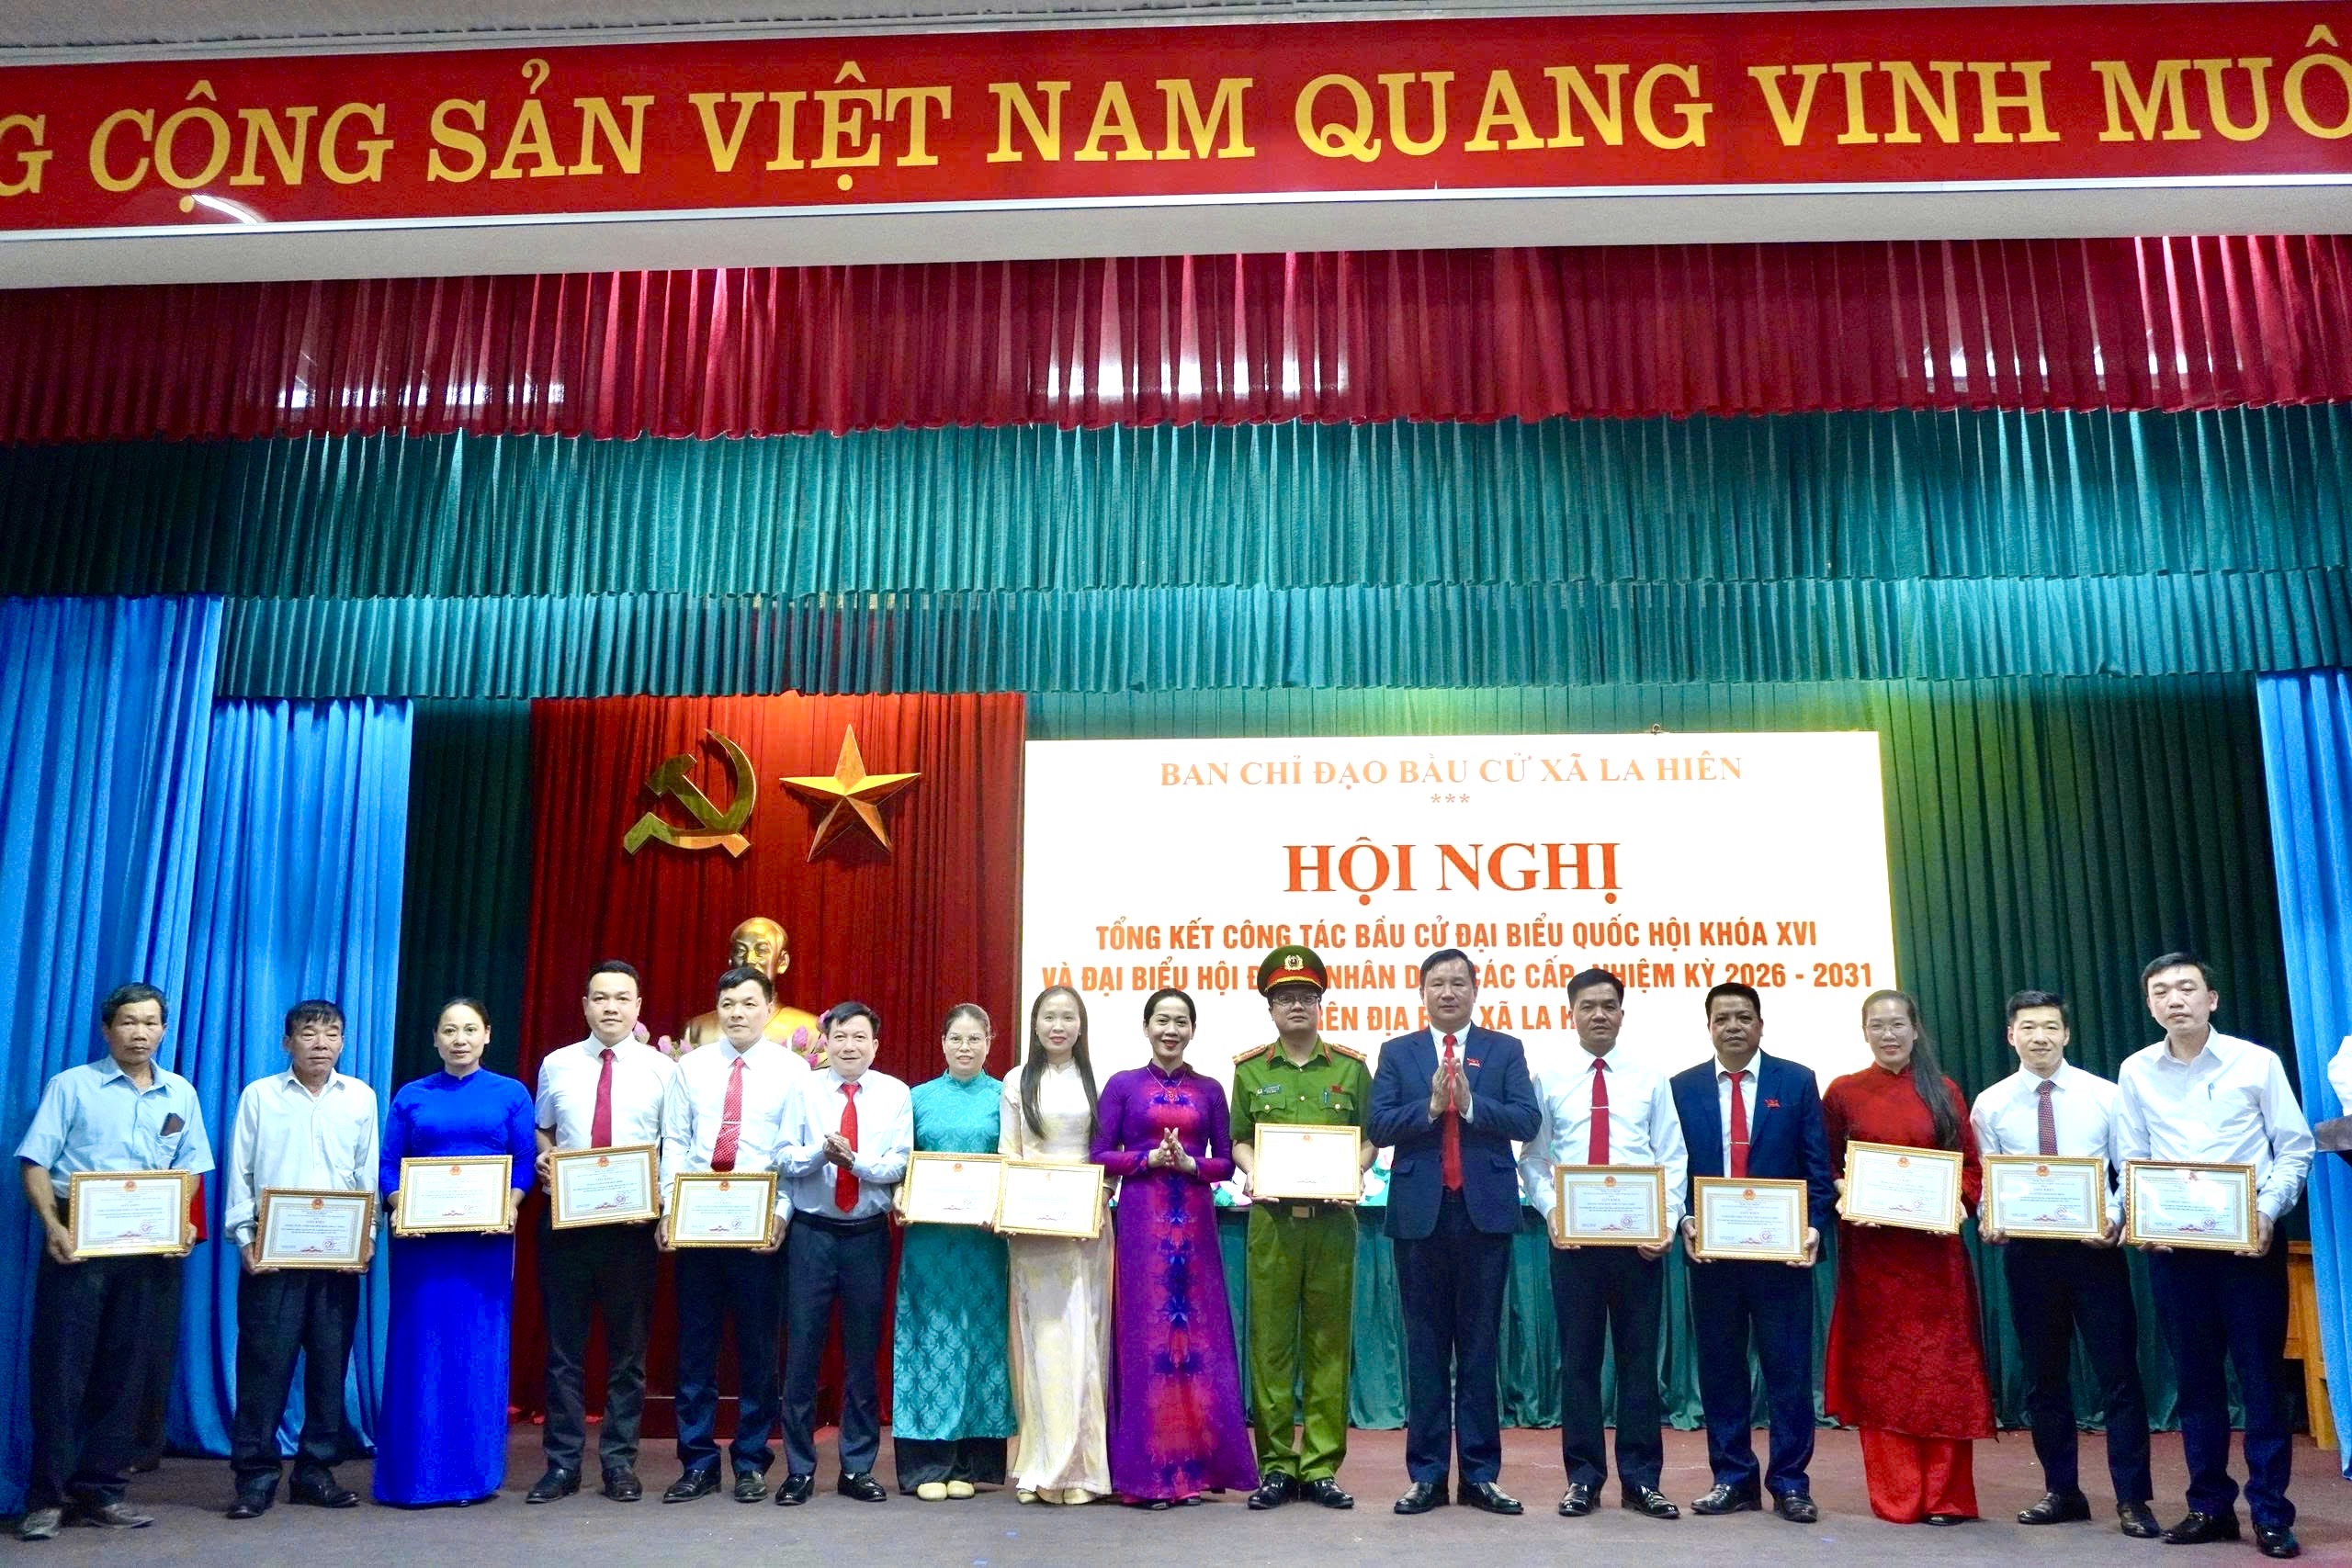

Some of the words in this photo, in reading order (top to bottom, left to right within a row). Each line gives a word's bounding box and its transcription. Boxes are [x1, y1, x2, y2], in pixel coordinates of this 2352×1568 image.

[89, 81, 394, 212] CỘNG
[427, 59, 655, 183] SẢN
[689, 61, 952, 191] VIỆT
[987, 77, 1256, 164] NAM
[1295, 63, 1713, 163] QUANG
[1747, 61, 2061, 147] VINH
[2091, 25, 2352, 142] MUÔ
[1160, 762, 1229, 786] BAN
[1239, 755, 1302, 785] CHỈ
[1313, 761, 1388, 790] ĐẠO
[1399, 753, 1467, 784] BẦU
[1478, 752, 1532, 783] CỬ
[1541, 752, 1589, 782] XÃ
[1600, 758, 1645, 782] LA
[1657, 750, 1742, 782] HIÊN
[1283, 837, 1418, 906] HỘI
[1435, 841, 1623, 905] NGHỊ
[1096, 916, 1160, 952] TỔNG
[1170, 917, 1215, 951] KẾT
[1223, 919, 1291, 950] CÔNG
[1300, 919, 1346, 950] TÁC
[1355, 916, 1405, 949] BẦU
[1414, 916, 1449, 949] CỬ
[1455, 921, 1498, 953] ĐẠI
[1507, 912, 1564, 948] BIỂU
[1573, 913, 1640, 950] QUỐC
[1649, 917, 1690, 953] HỘI
[1699, 916, 1767, 947] KHÓA
[1776, 920, 1817, 947] XVI
[1042, 961, 1073, 990] VÀ
[1081, 966, 1123, 997] ĐẠI
[1132, 955, 1189, 991] BIỂU
[1197, 960, 1238, 996] HỘI
[1326, 959, 1396, 990] NHÂN
[1684, 957, 1715, 989] KỲ
[1724, 963, 1786, 989] 2026
[1813, 962, 1871, 988] 2031
[1366, 1005, 1410, 1037] ĐỊA
[1479, 1000, 1513, 1031] XÃ
[1521, 1005, 1552, 1031] LA
